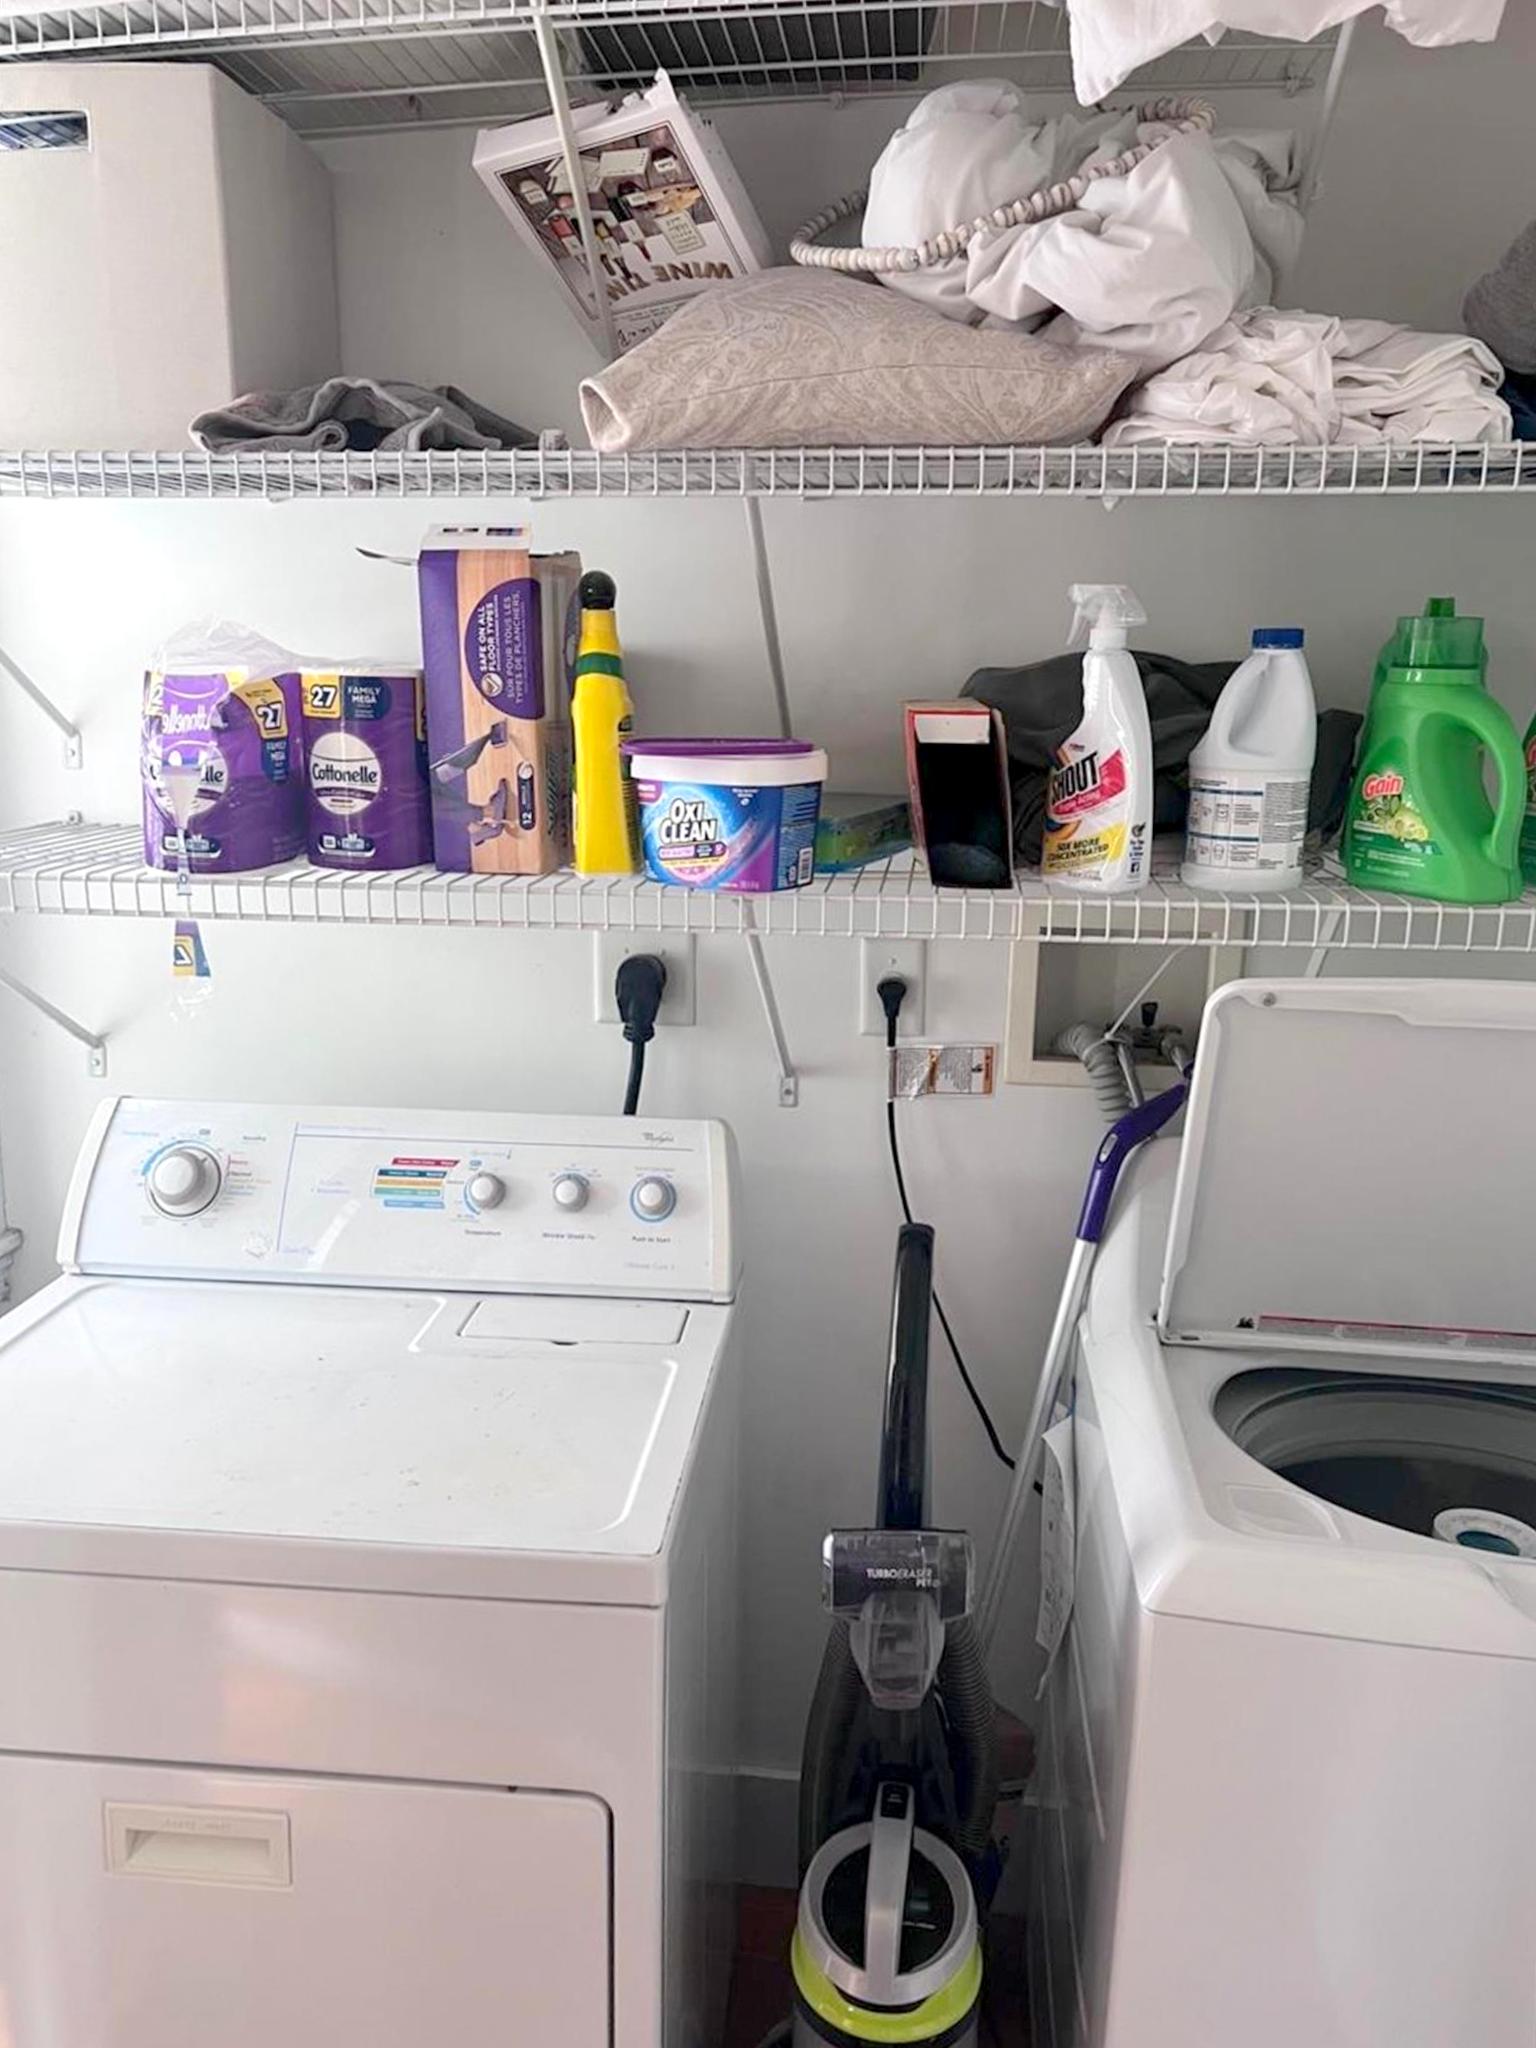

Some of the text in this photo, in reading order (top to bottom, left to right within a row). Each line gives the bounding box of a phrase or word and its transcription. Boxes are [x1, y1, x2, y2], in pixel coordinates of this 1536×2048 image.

[653, 261, 734, 283] WINE
[477, 606, 488, 672] SAFE ON ALL
[485, 602, 496, 672] FLOOR TYPES
[310, 684, 337, 708] 27
[347, 685, 382, 695] FAMILY
[256, 701, 282, 730] 27
[312, 763, 377, 783] Cottonelle
[1364, 774, 1402, 799] Gain
[670, 798, 704, 824] OXI
[660, 818, 718, 844] CLEAN
